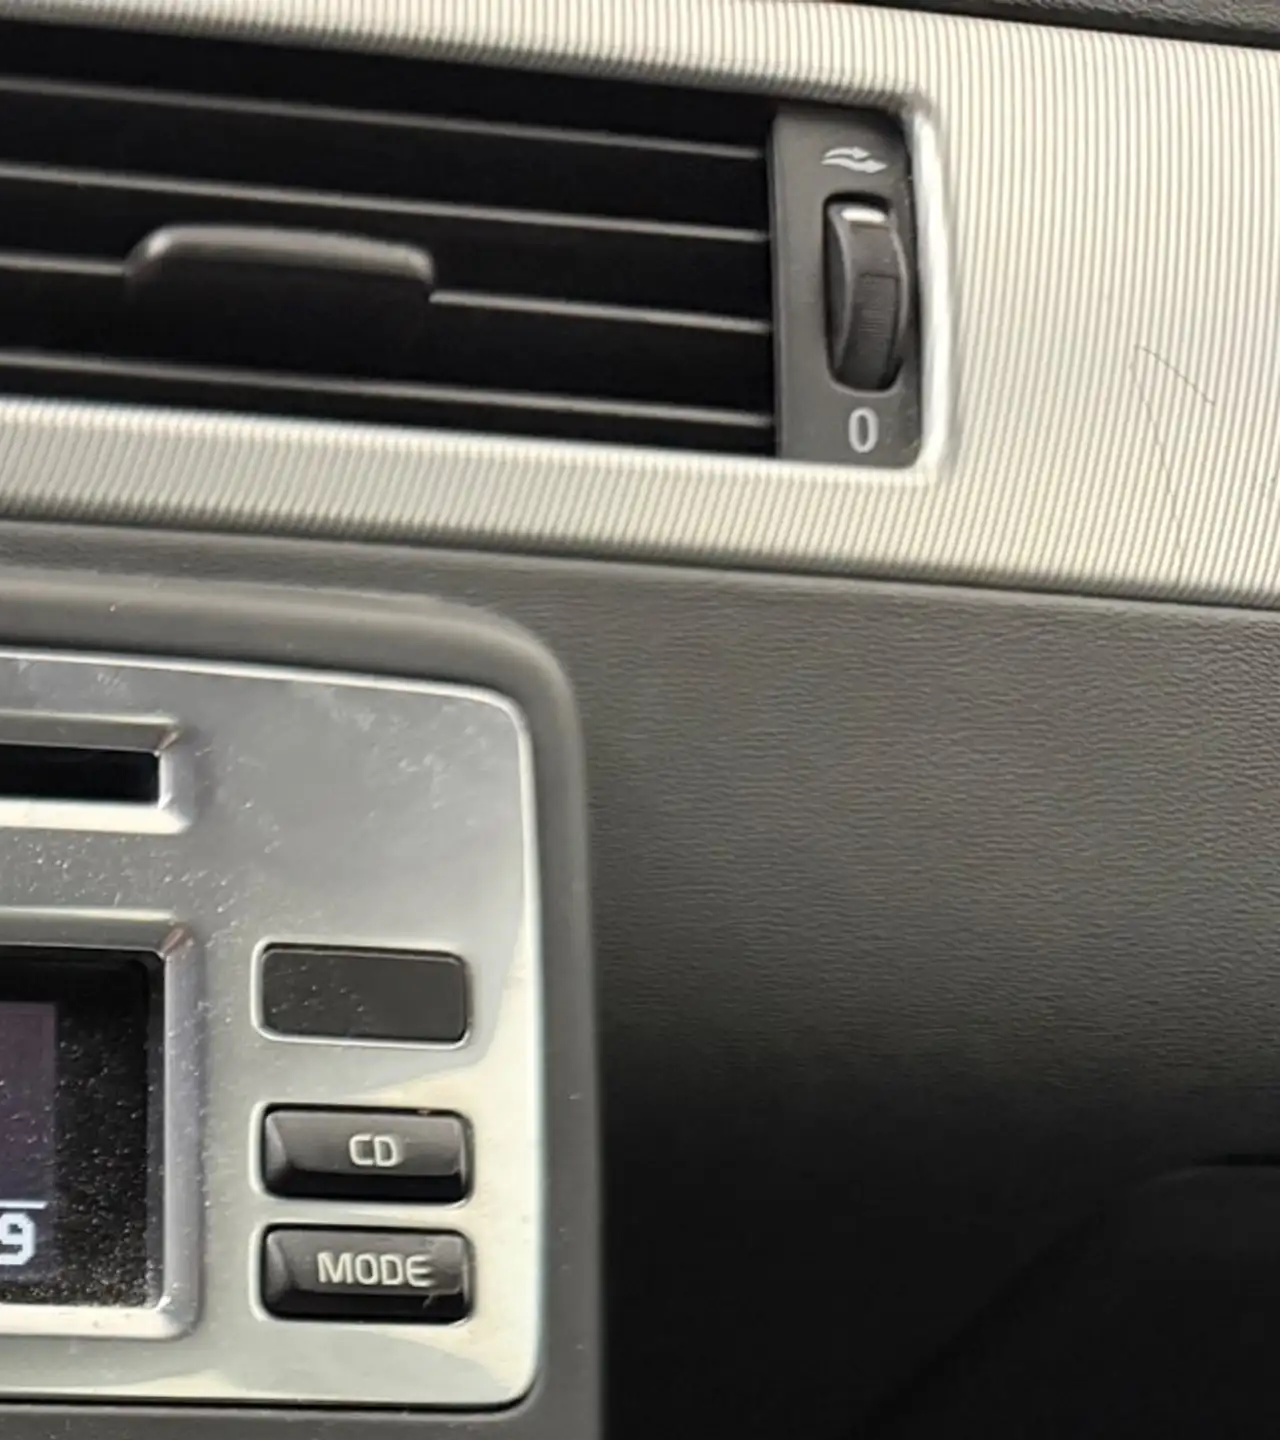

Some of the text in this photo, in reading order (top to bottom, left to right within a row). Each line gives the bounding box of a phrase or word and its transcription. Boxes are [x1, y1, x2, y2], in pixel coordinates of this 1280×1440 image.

[848, 407, 878, 453] 0
[348, 1133, 402, 1167] CD
[316, 1251, 434, 1287] MODE
